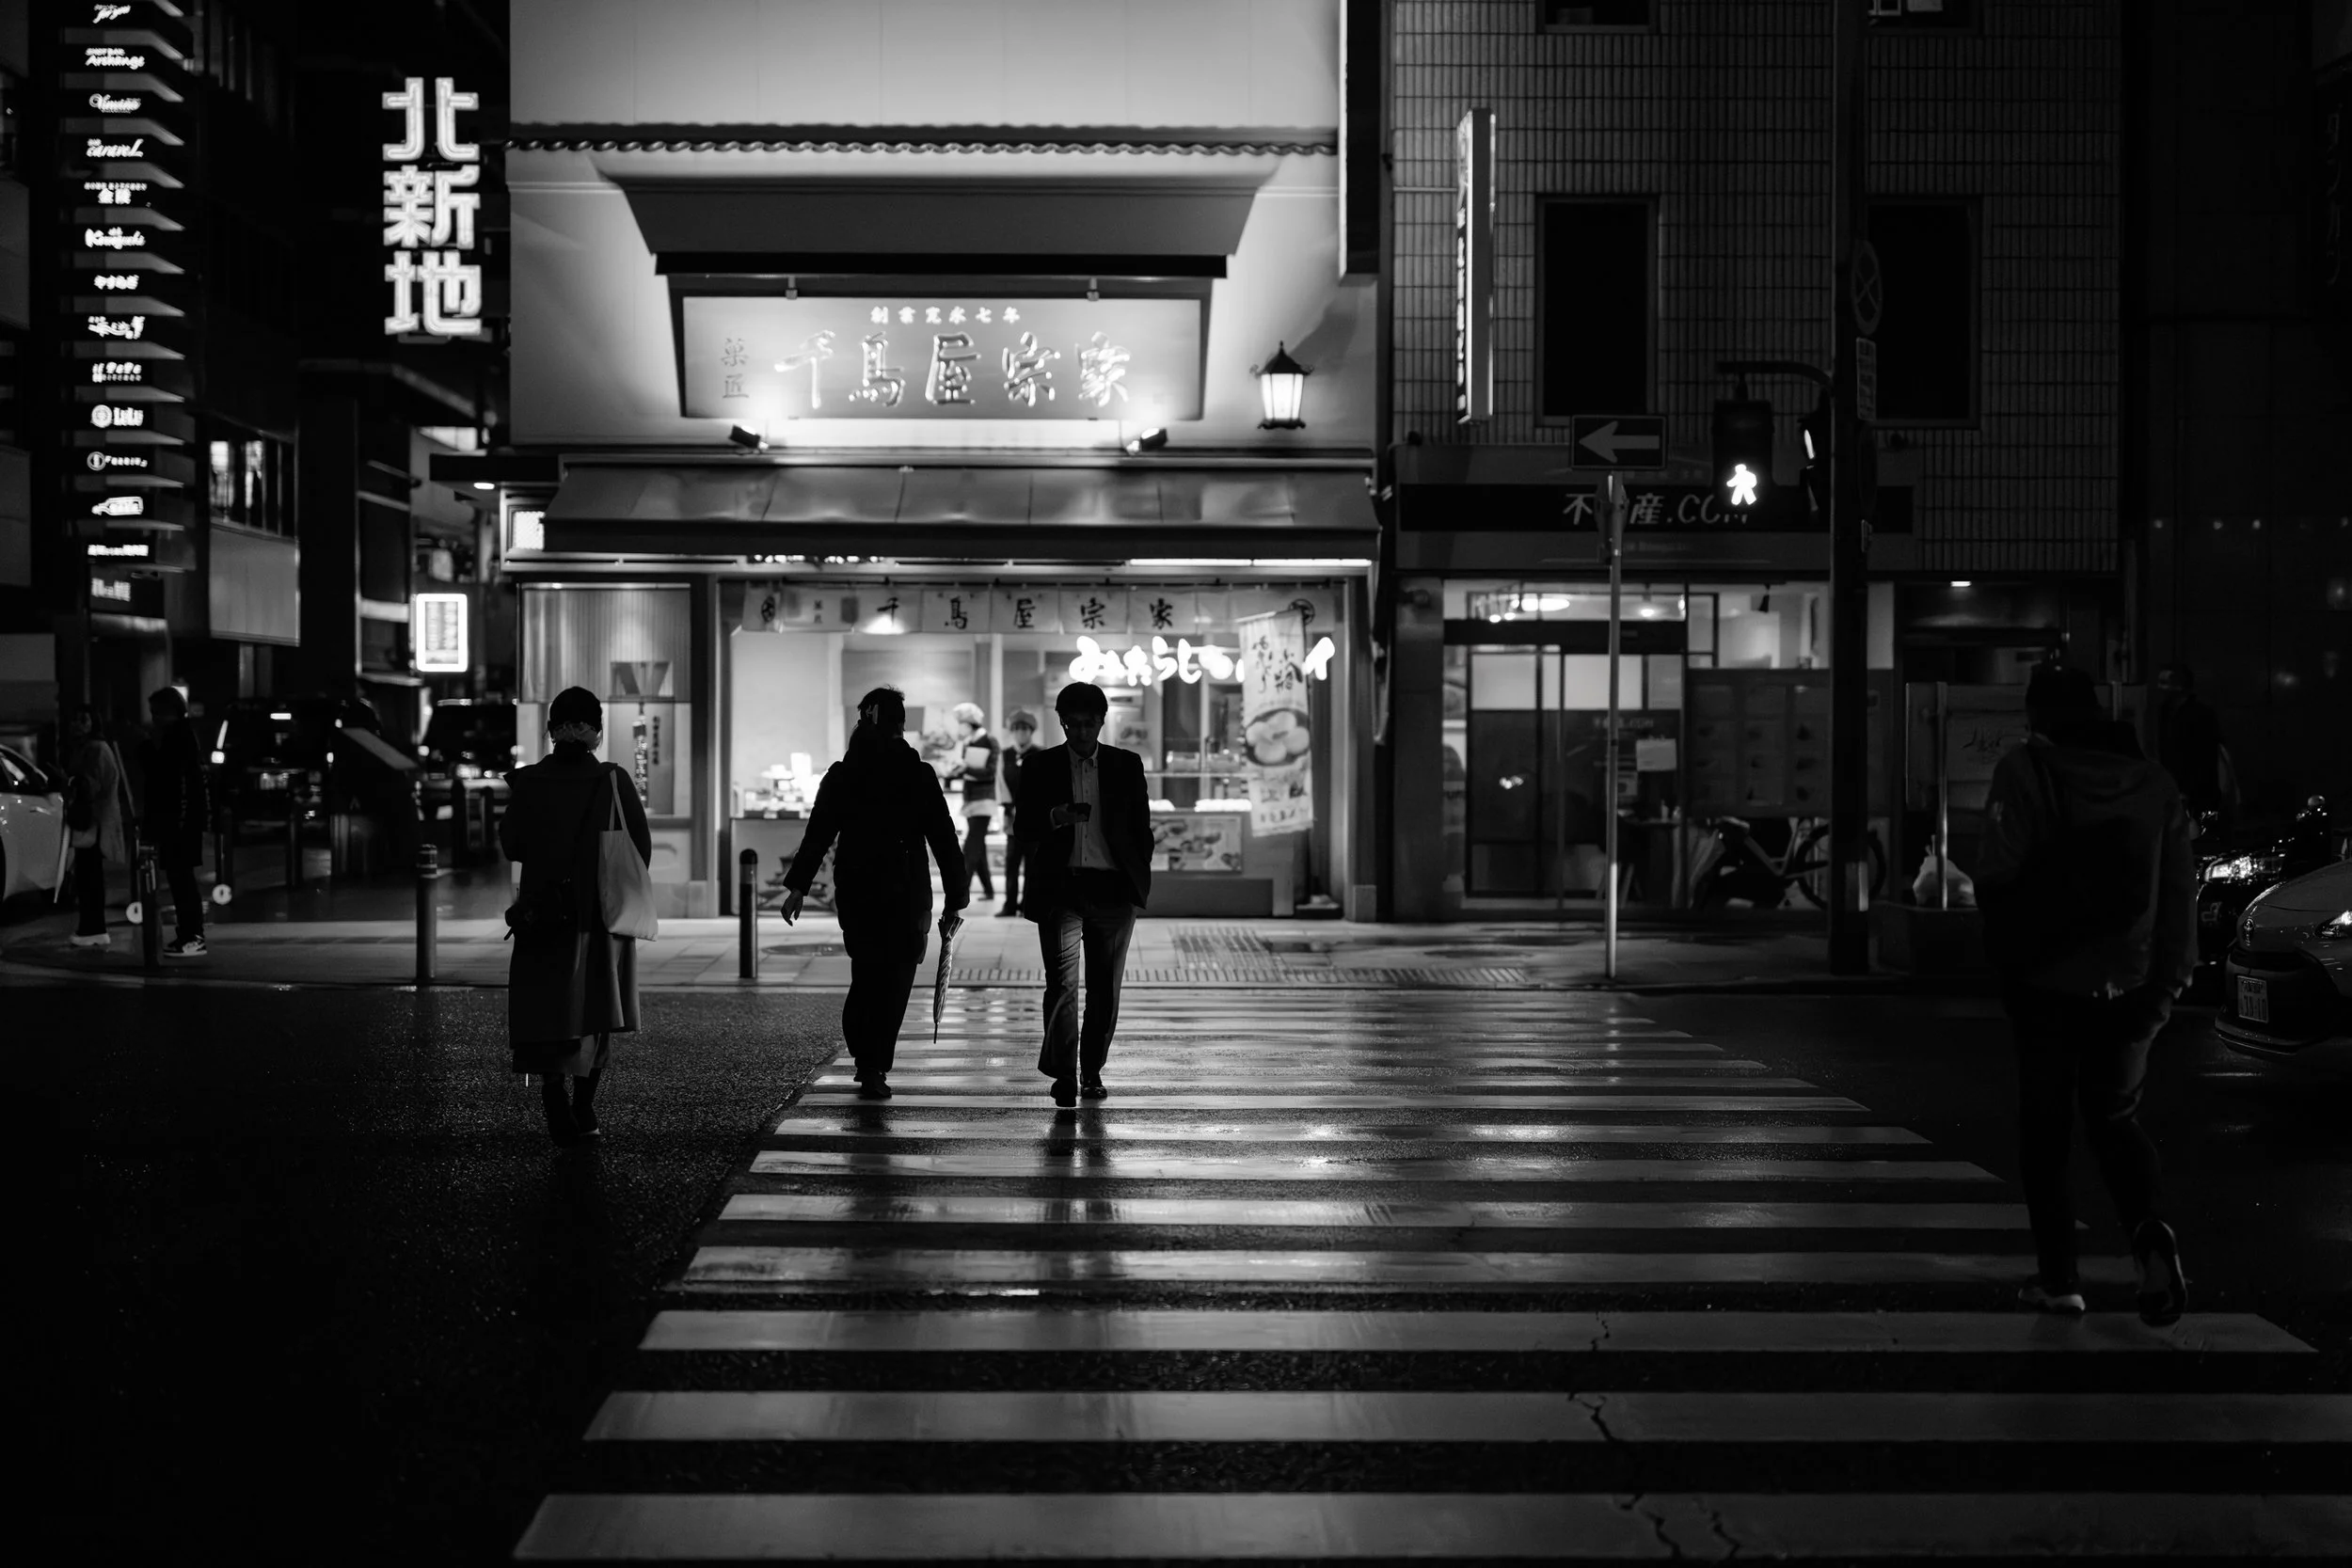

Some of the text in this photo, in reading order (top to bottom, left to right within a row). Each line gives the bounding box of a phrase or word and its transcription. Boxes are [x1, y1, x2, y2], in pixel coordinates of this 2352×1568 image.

[382, 77, 482, 336] 北新地
[773, 329, 1131, 407] 千鳥屋宗家
[877, 595, 1173, 630] 千鳥屋宗家
